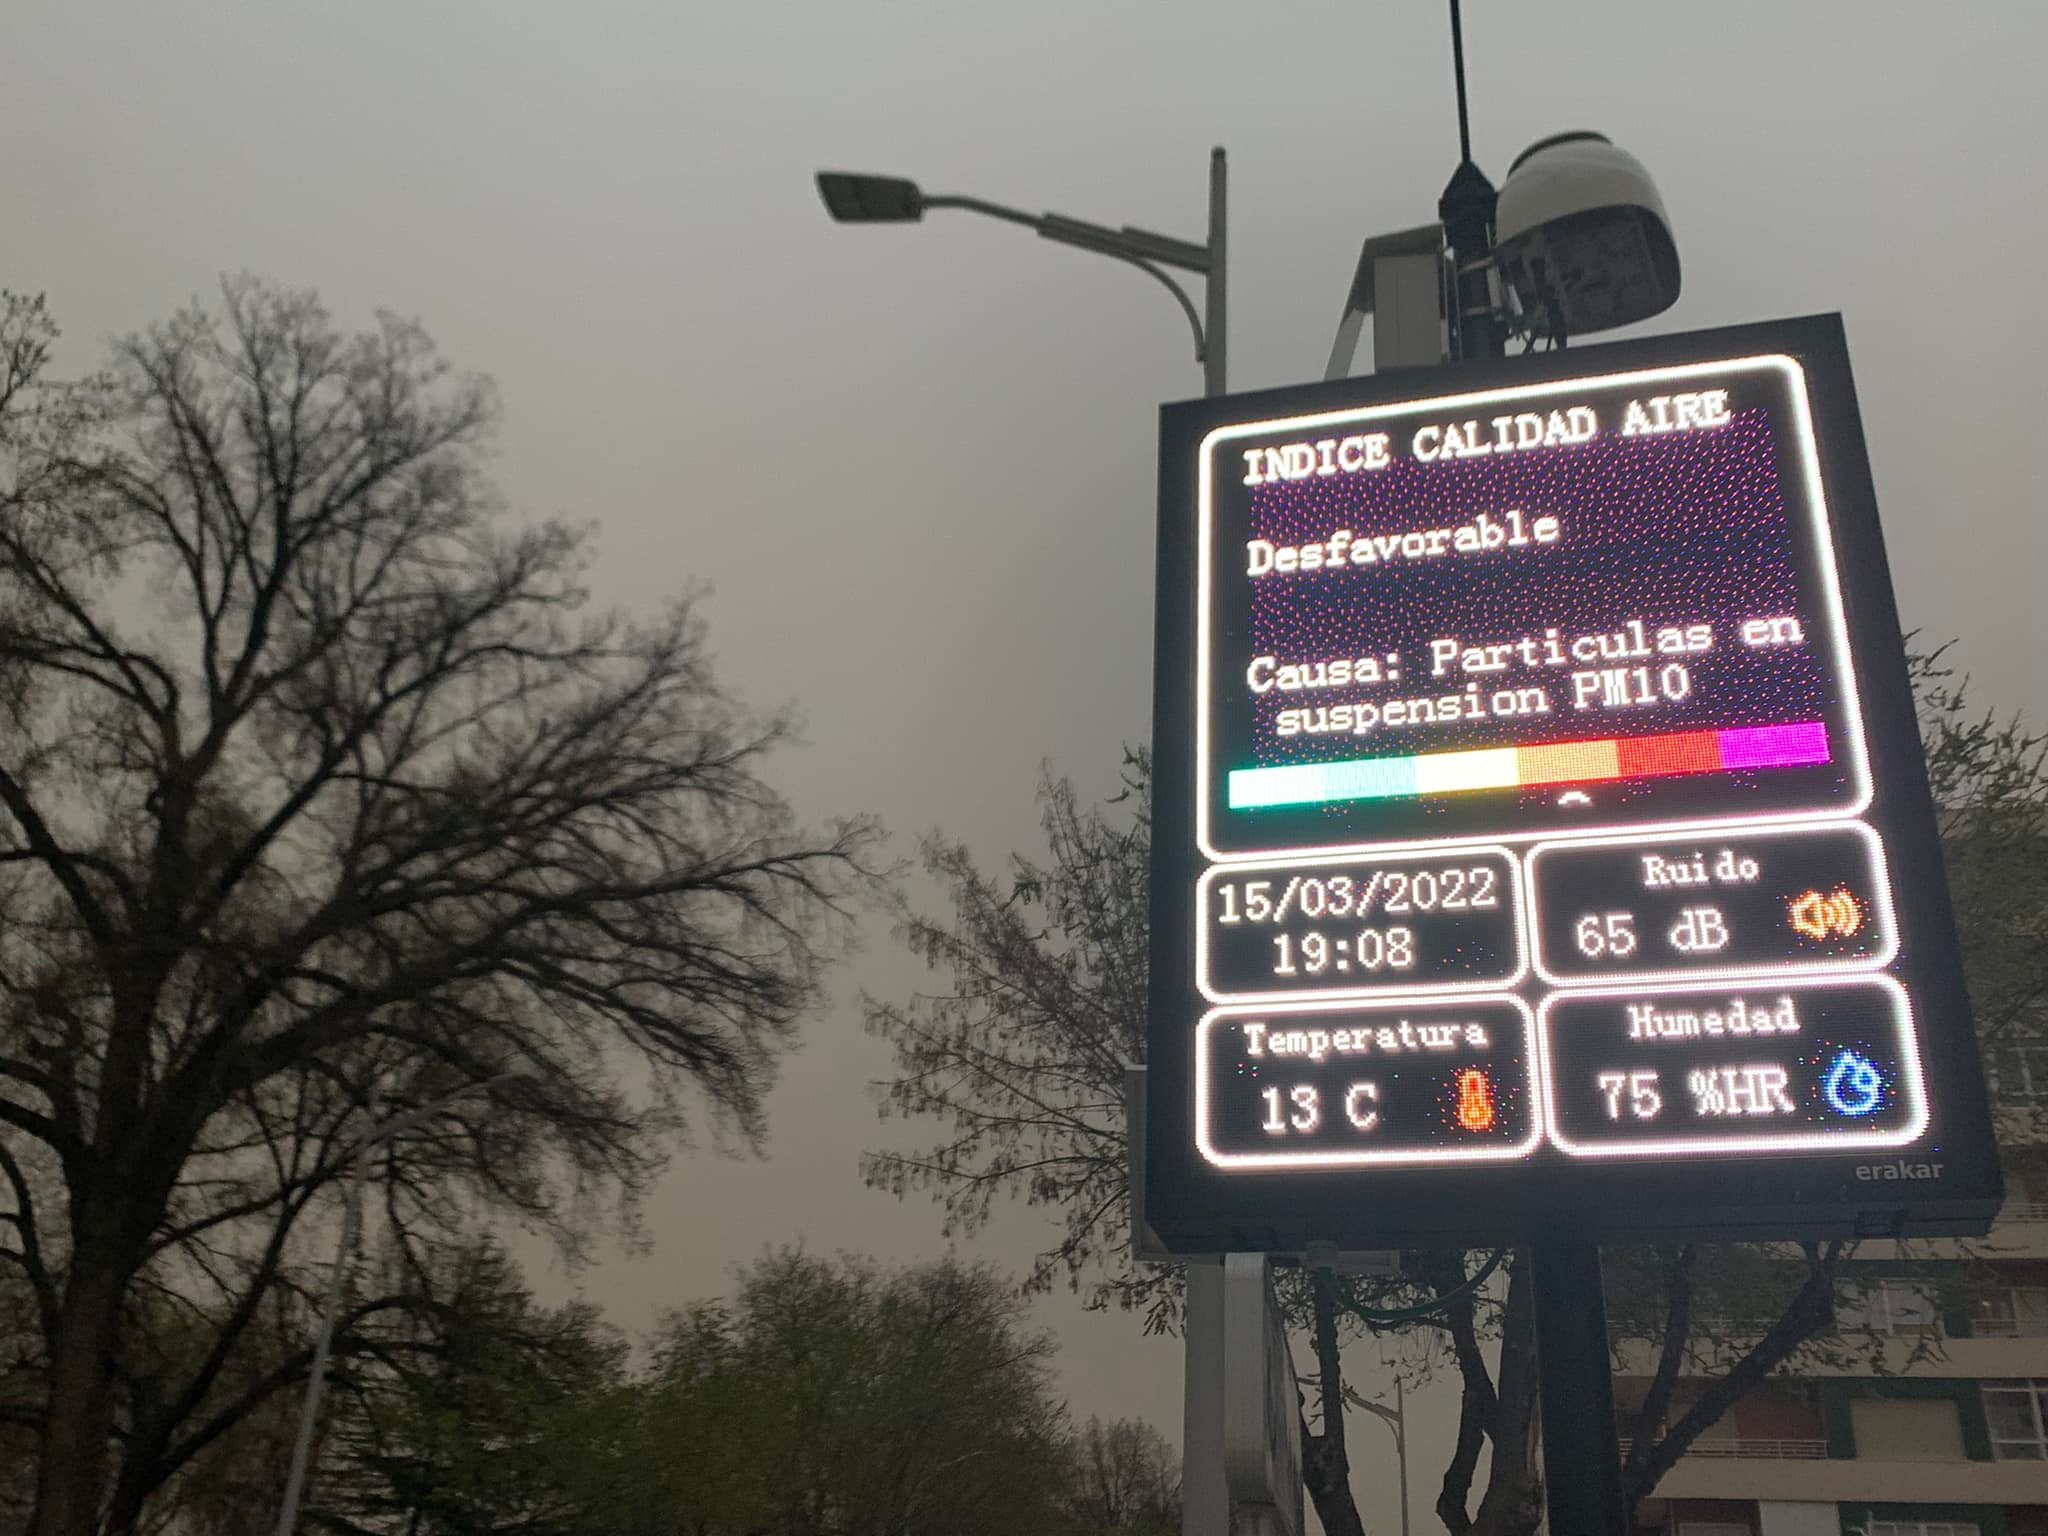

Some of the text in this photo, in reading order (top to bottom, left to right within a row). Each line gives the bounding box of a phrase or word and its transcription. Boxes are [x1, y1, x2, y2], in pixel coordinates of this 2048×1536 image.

[1242, 389, 1731, 485] INDICE CALIDAD AIRE
[1246, 509, 1559, 576] Desfavorable
[1246, 614, 1804, 693] Causa: Particulas en
[1276, 661, 1690, 736] suspension PM10
[1641, 848, 1760, 887] Ruido
[1218, 867, 1497, 922] 15/03/2022
[1273, 927, 1413, 975] 19:08
[1576, 907, 1729, 957] 65 dB
[1244, 1020, 1489, 1060] Temperatura
[1627, 996, 1800, 1039] Humedad
[1261, 1081, 1378, 1132] 13 C
[1599, 1064, 1796, 1120] 75 %HR
[1855, 1160, 1944, 1181] erakar
